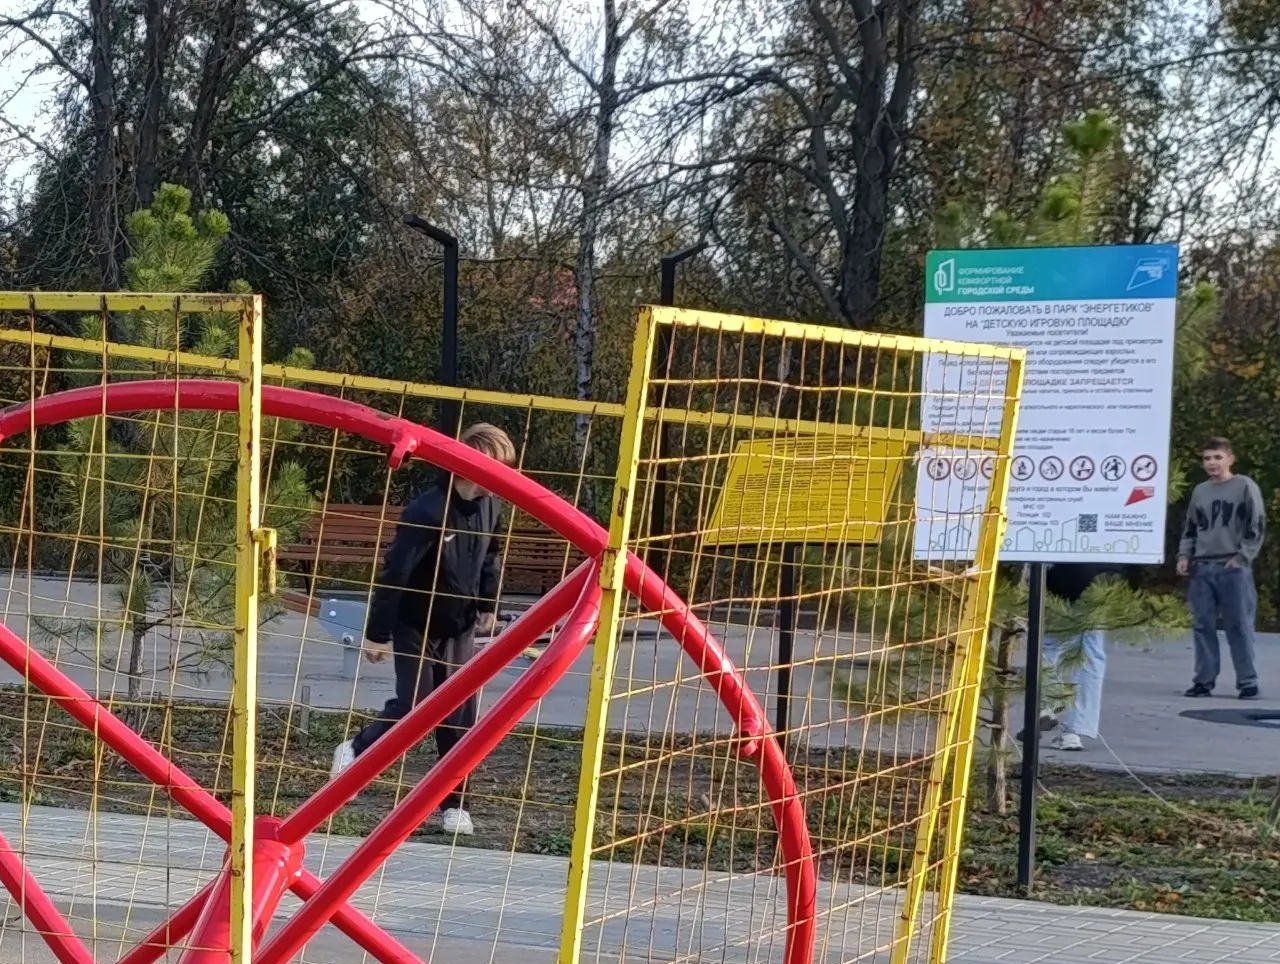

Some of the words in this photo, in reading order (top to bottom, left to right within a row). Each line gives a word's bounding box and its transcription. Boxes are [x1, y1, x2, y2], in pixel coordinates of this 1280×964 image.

[957, 265, 1024, 275] ФОРМИРОВАНИЕ
[957, 275, 1012, 285] КОМФОРТНОЙ
[957, 285, 1005, 296] ГОРОДСКОЙ
[1006, 285, 1035, 295] СРЕДЫ
[944, 306, 977, 317] ДОБРО
[979, 304, 1042, 316] ПОЖАЛОВАТЬ
[1045, 304, 1051, 314] В
[1053, 304, 1078, 314] ПАРК
[966, 319, 978, 329] НА
[1030, 317, 1075, 328] ИГРОВУЮ
[1070, 377, 1134, 386] ЗАПРЕЩАЕТСЯ
